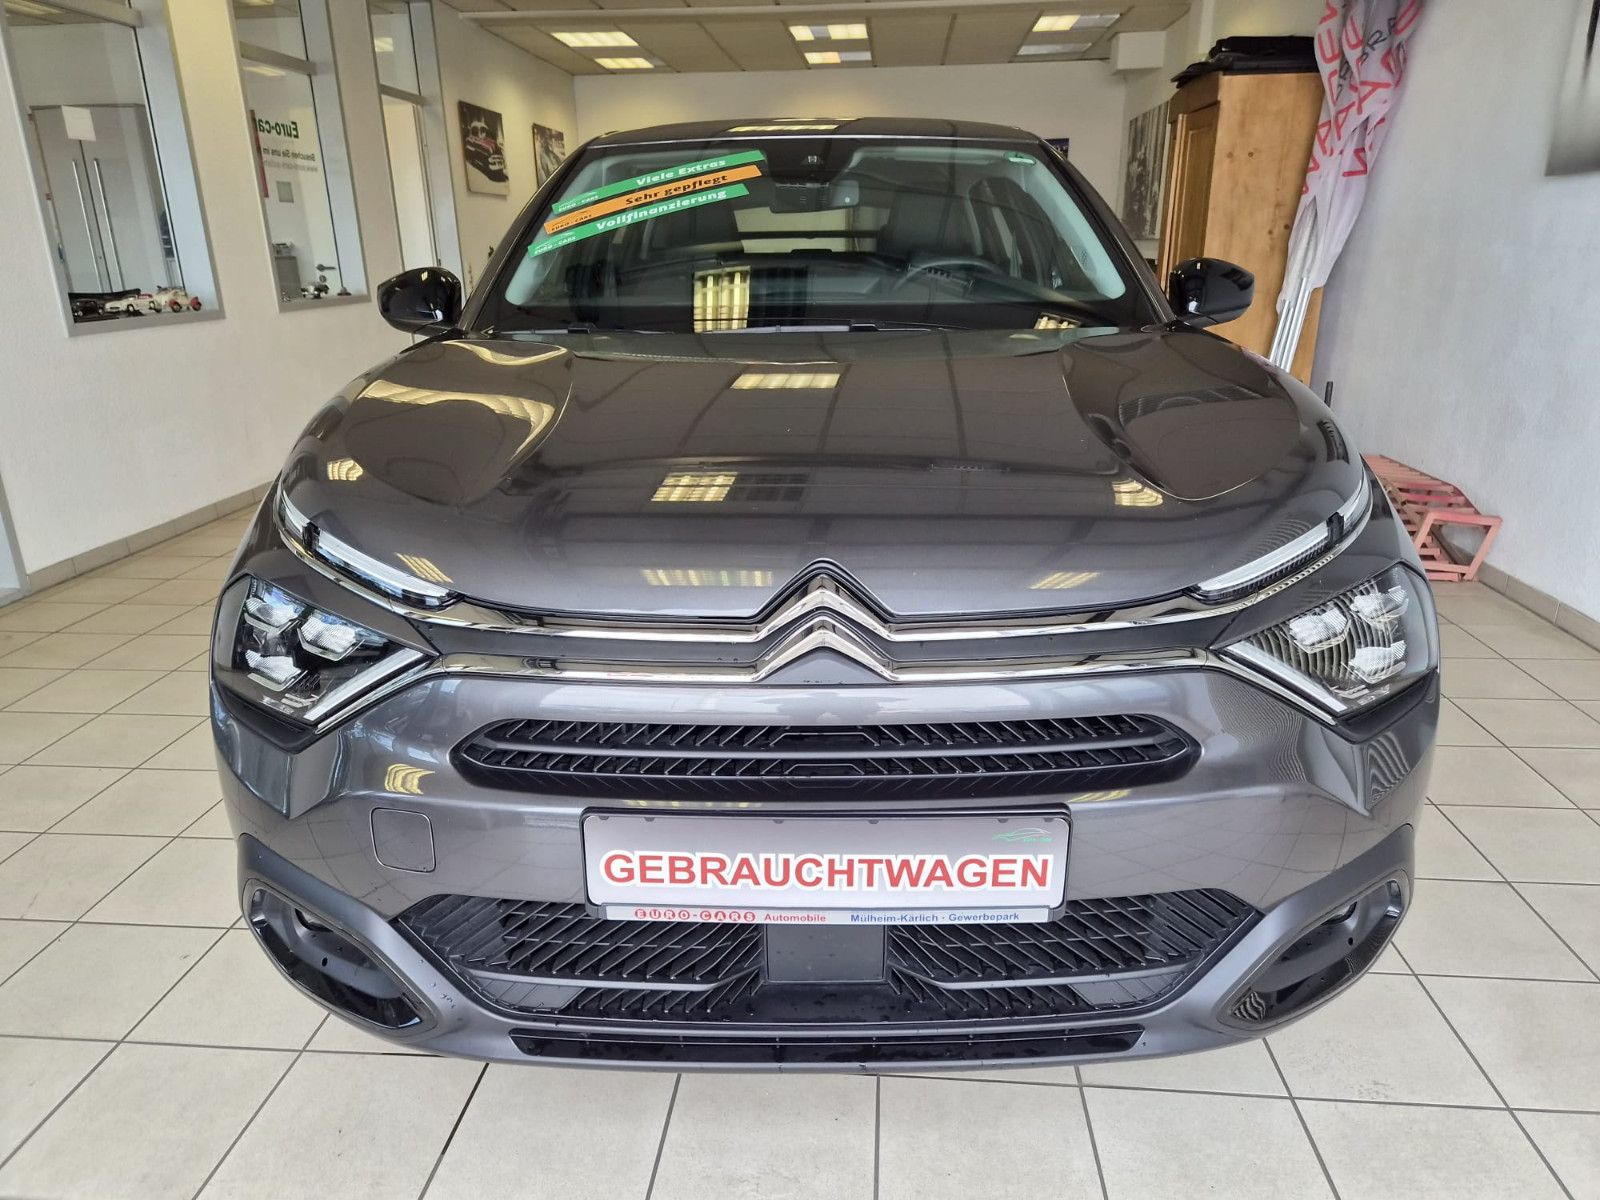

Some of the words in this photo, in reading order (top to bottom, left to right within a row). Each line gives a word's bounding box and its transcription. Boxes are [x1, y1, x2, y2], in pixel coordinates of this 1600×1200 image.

[636, 171, 674, 186] Viele
[678, 160, 726, 175] Extras
[625, 190, 660, 205] Sehr
[664, 175, 728, 197] gepflegt
[596, 189, 727, 231] Vollfinanzierung
[602, 853, 1050, 889] GEBRAUCHTWAGEN
[764, 913, 827, 923] Automobile
[949, 911, 1020, 924] Gewerbepark
